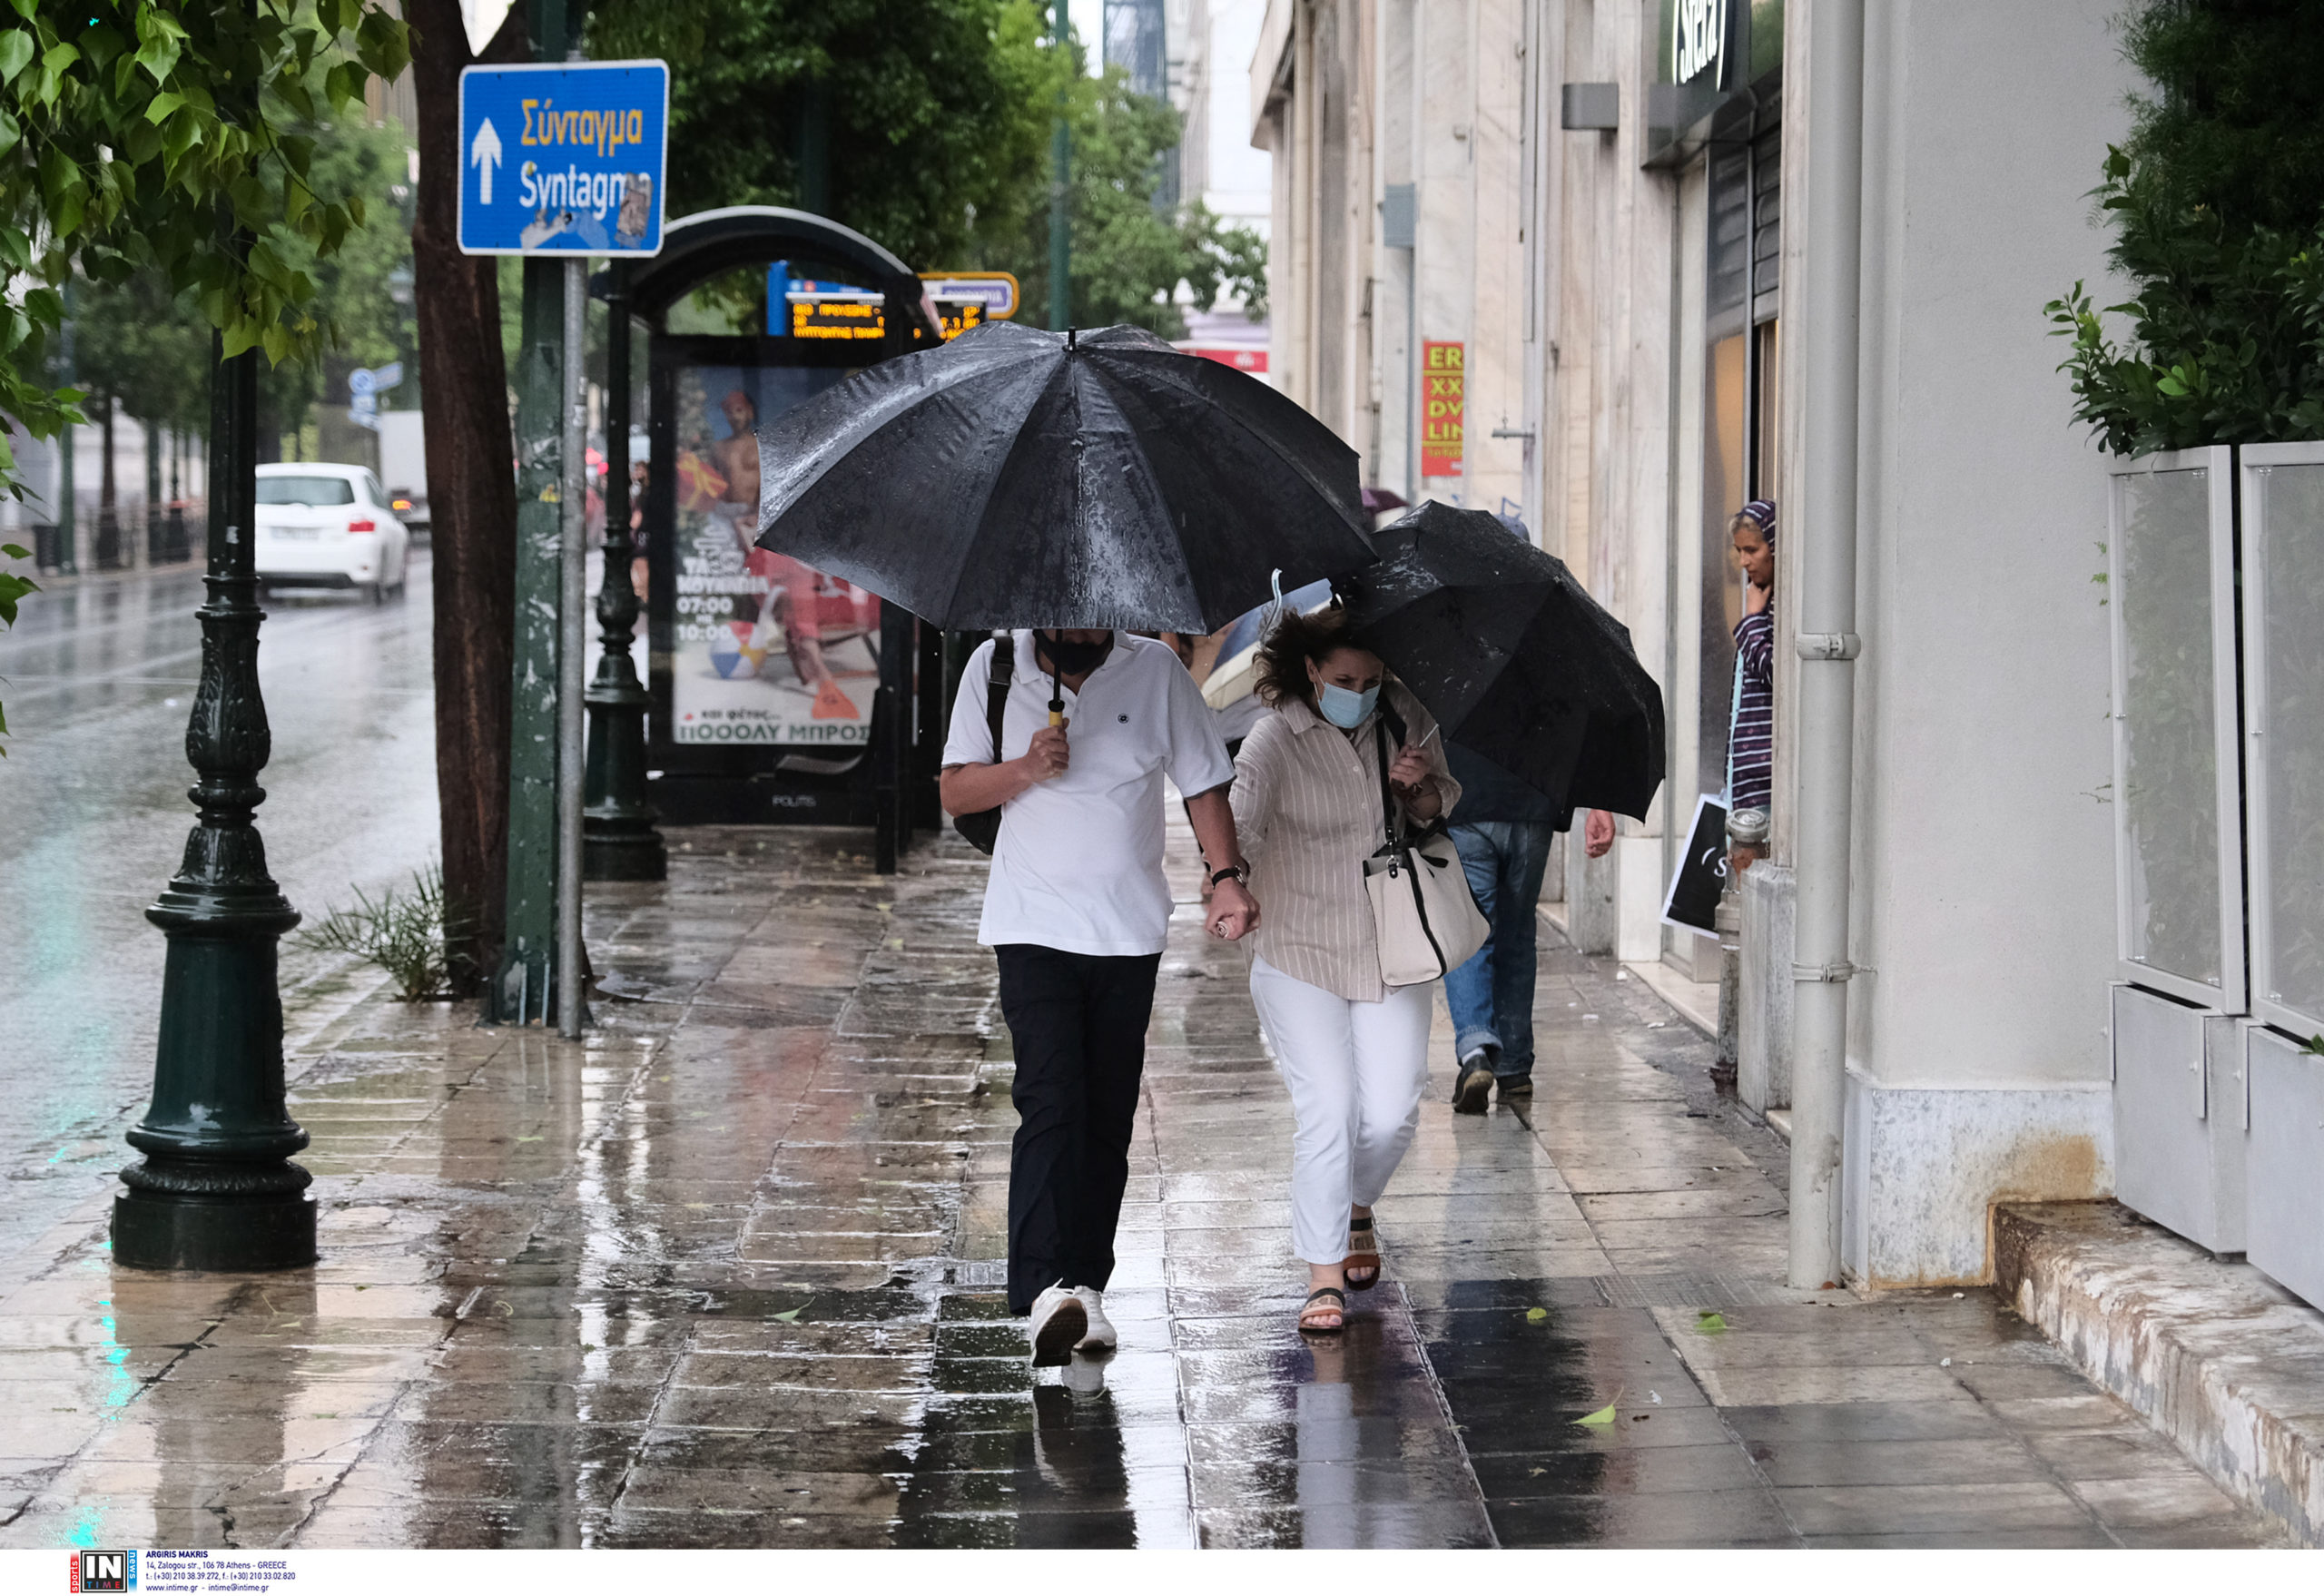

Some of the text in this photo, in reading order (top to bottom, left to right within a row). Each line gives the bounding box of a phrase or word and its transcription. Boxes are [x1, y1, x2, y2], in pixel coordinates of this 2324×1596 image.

[521, 98, 643, 157] Σύνταγμα
[1429, 346, 1462, 369] ER
[1429, 377, 1462, 397] XX
[675, 596, 734, 615] 07:00
[676, 624, 732, 641] 10:00
[681, 724, 779, 740] ΠΟΟΟΛΥ
